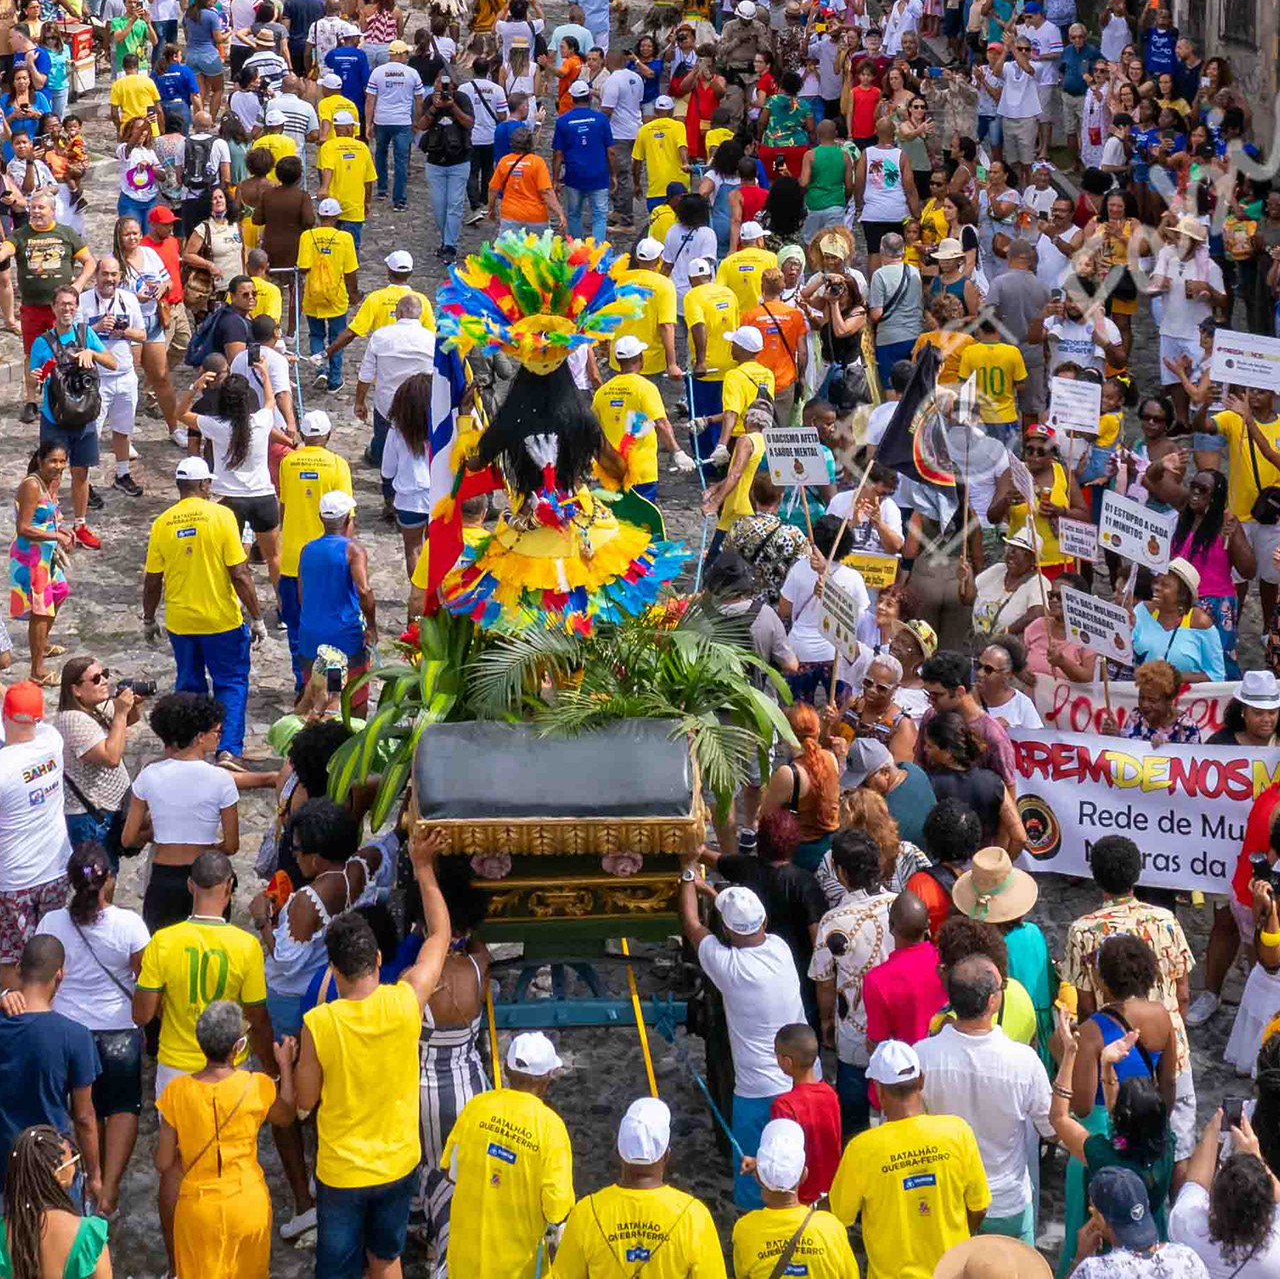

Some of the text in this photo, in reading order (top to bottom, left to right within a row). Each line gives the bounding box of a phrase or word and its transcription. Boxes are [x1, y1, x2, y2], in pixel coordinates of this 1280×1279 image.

[979, 366, 1004, 396] 10
[766, 433, 819, 444] O RACISMO AFETA
[769, 446, 819, 458] A SAÚDE MENTAL
[1104, 515, 1143, 541] 11 MINUTOS
[1114, 506, 1144, 528] ESTUPRO
[1149, 523, 1169, 539] CADA
[1066, 604, 1115, 631] ENCARCERADAS
[1093, 604, 1127, 625] MULHERES
[1082, 622, 1107, 639] NEGRAS
[1078, 801, 1149, 832] Rede
[1157, 815, 1193, 837] de
[1197, 851, 1227, 877] da
[185, 947, 228, 1004] 10
[479, 1121, 539, 1152] QUEBRA-FERRO
[490, 1115, 532, 1140] BATALHÃO
[881, 1153, 950, 1173] QUEBRA-FERRO
[890, 1144, 938, 1162] BATALHÃO
